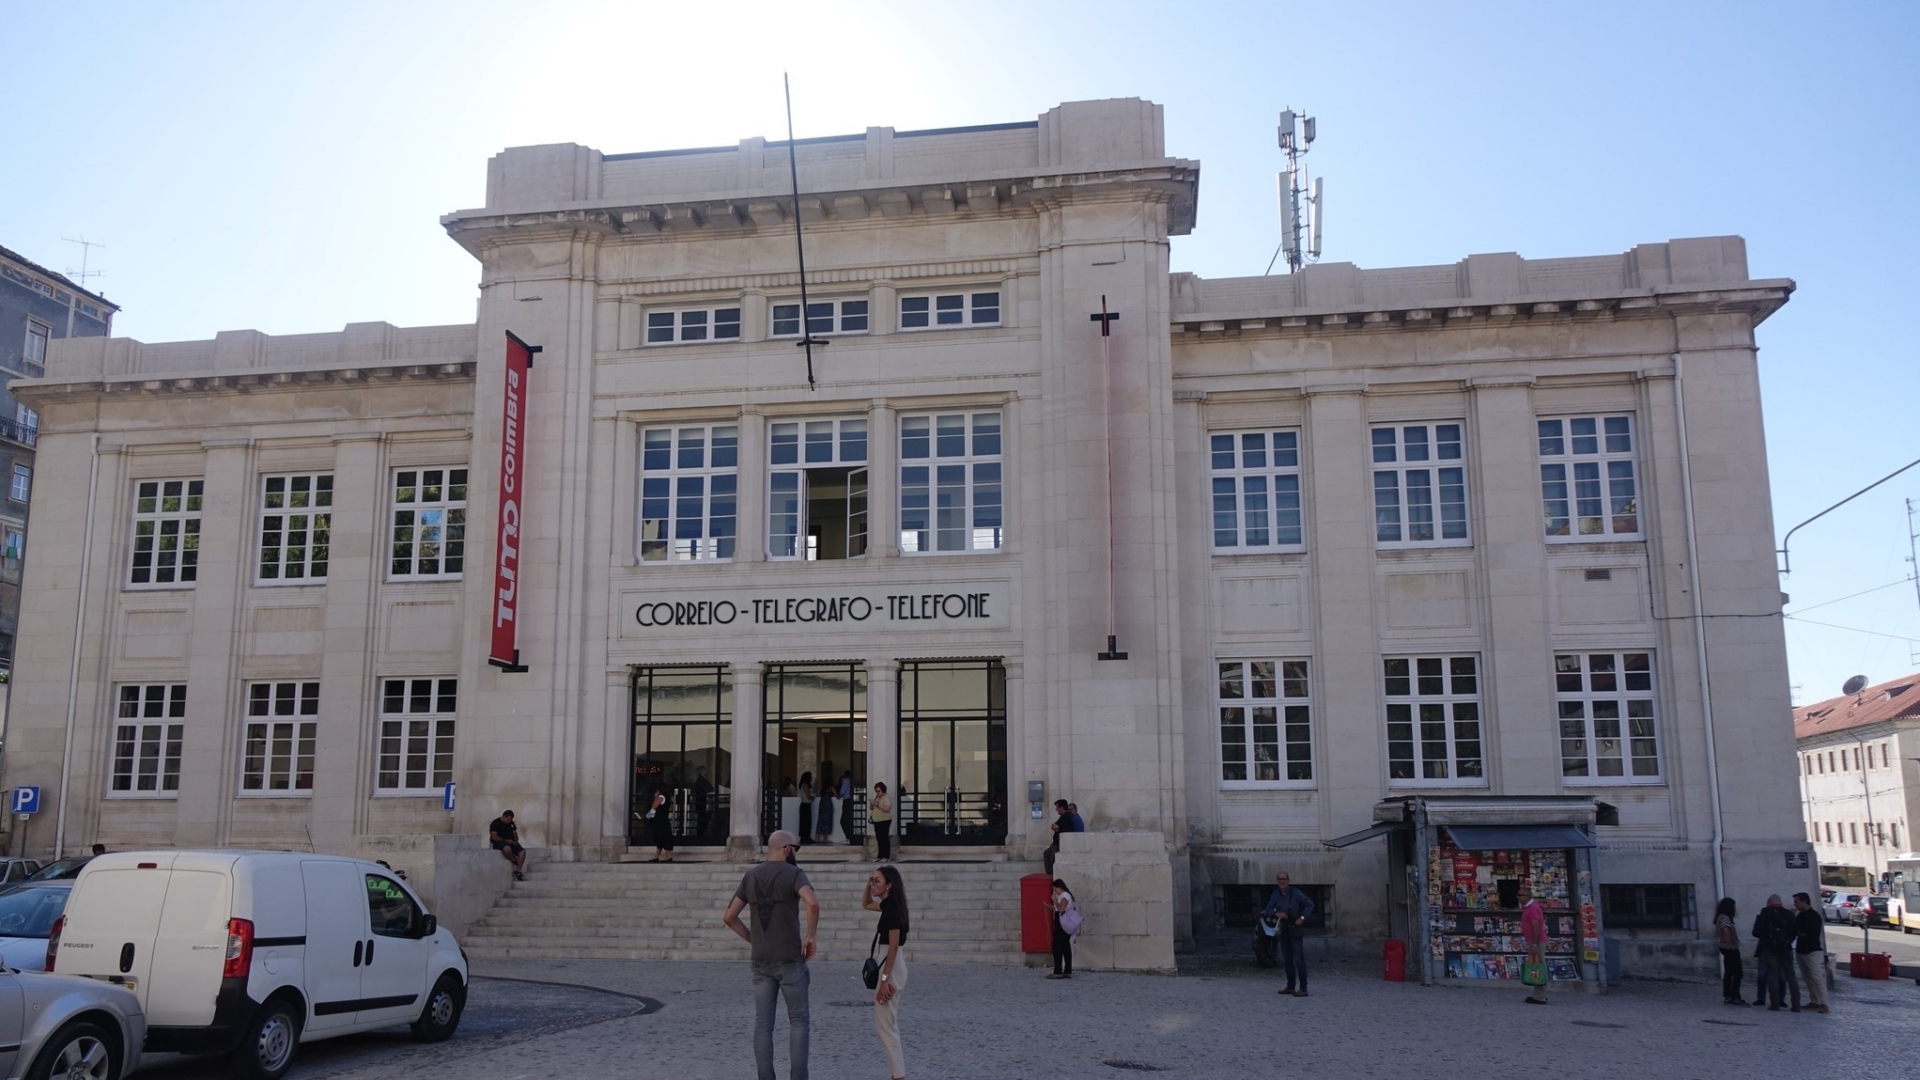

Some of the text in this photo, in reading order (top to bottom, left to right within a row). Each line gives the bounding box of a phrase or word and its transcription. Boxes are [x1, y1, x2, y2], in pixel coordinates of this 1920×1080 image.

[635, 600, 737, 627] CORREIO
[752, 596, 872, 624] TELEGRAFO
[886, 592, 991, 621] TELEFONE
[17, 788, 34, 811] P
